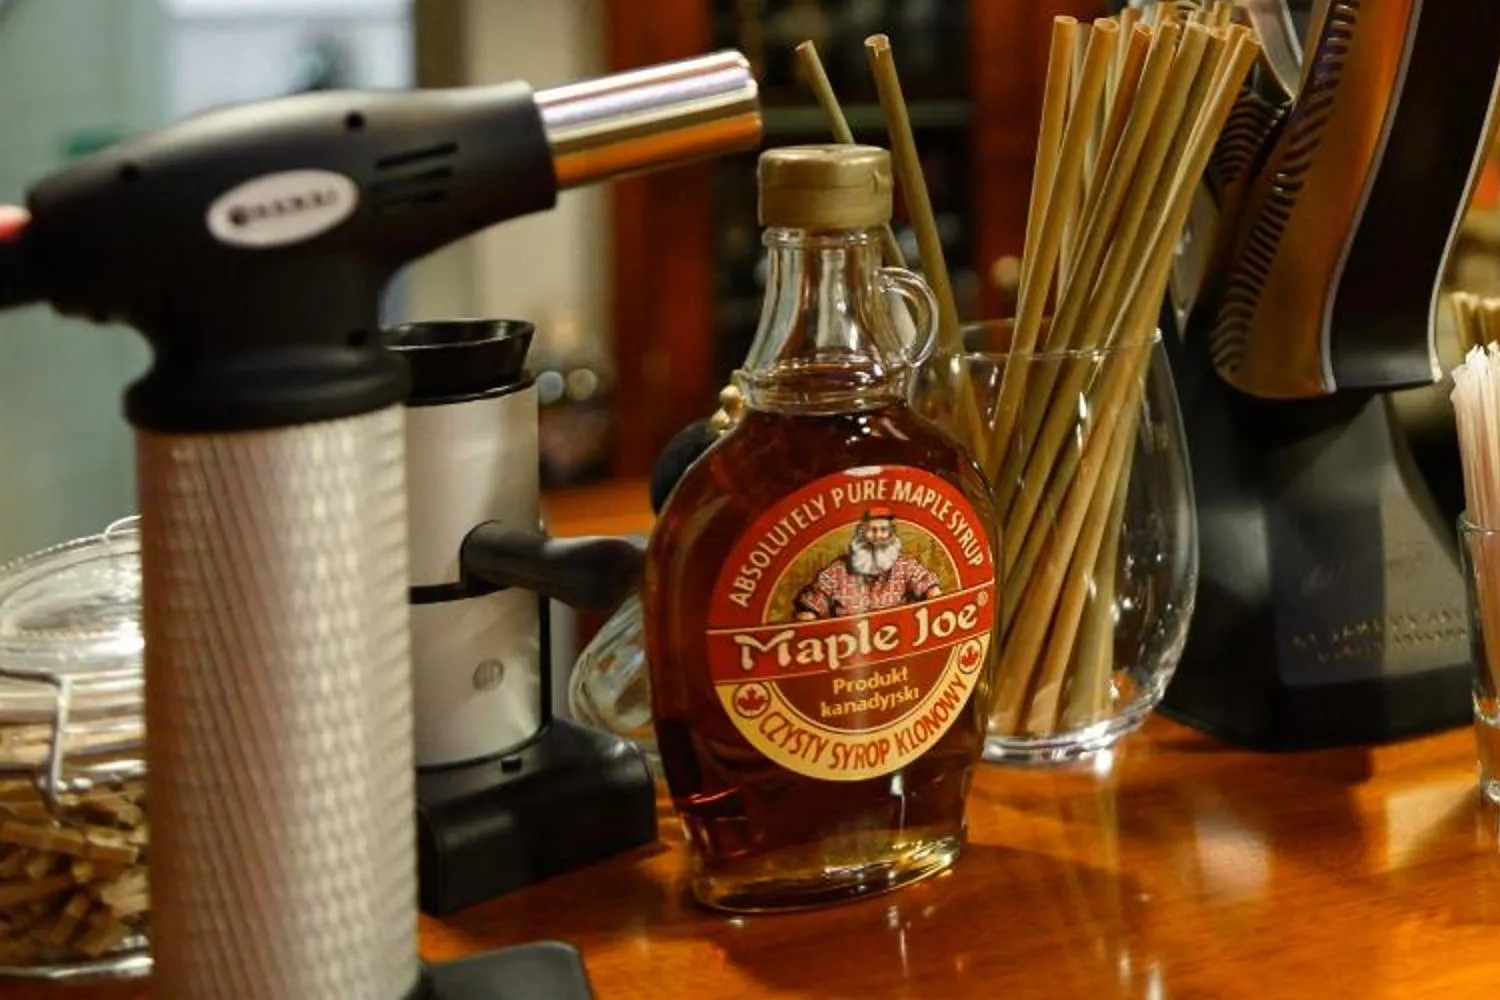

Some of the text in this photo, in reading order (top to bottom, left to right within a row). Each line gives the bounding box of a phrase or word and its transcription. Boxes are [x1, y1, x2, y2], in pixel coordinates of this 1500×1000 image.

[729, 479, 985, 608] ABSOLUTELY PURE MAPLE SYRUP
[733, 617, 899, 671] Maple
[819, 685, 920, 718] kanadyjski
[832, 665, 909, 695] Produkt
[757, 672, 969, 771] CZYSTY SYROP KLONOWY
